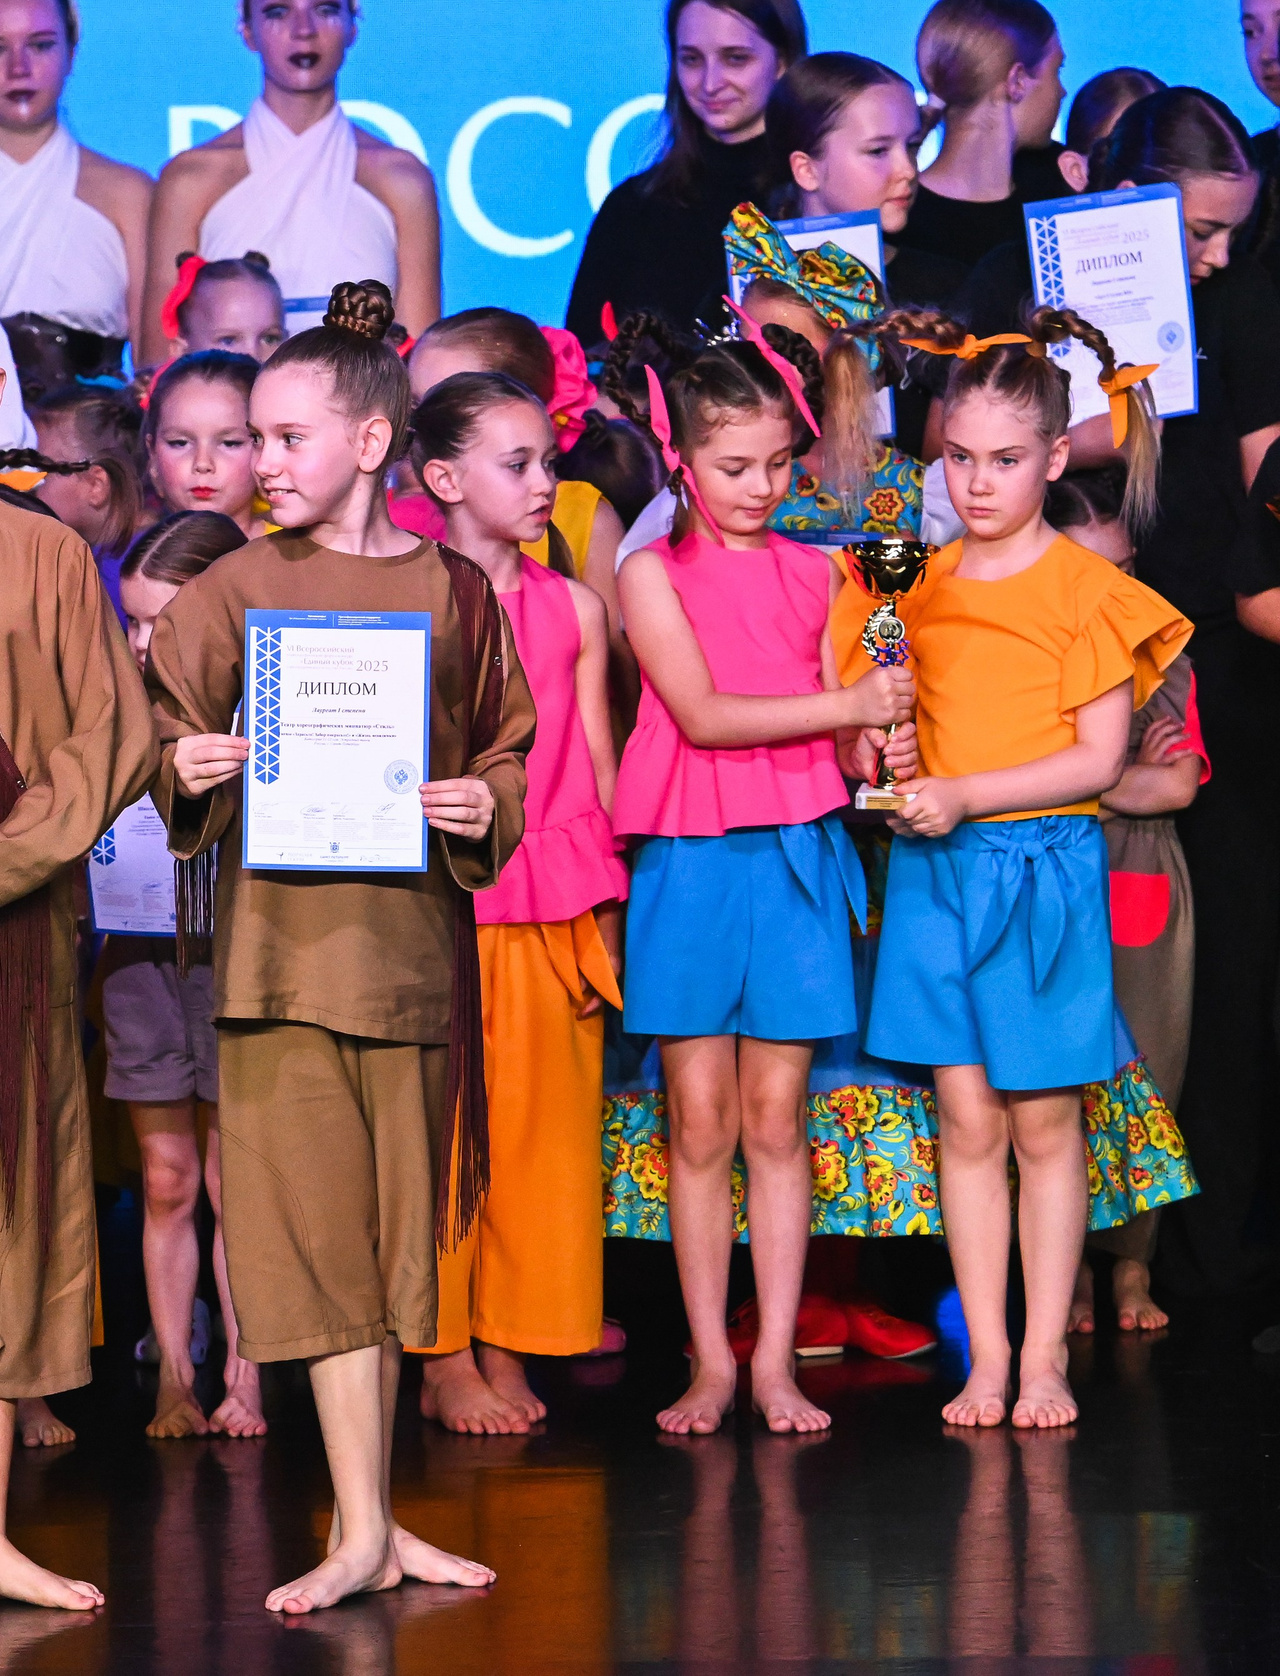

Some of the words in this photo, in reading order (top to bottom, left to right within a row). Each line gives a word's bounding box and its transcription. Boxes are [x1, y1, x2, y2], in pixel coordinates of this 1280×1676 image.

[1075, 251, 1143, 275] ДИПЛОМ
[356, 660, 389, 672] 2025
[297, 681, 377, 698] ДИПЛОМ
